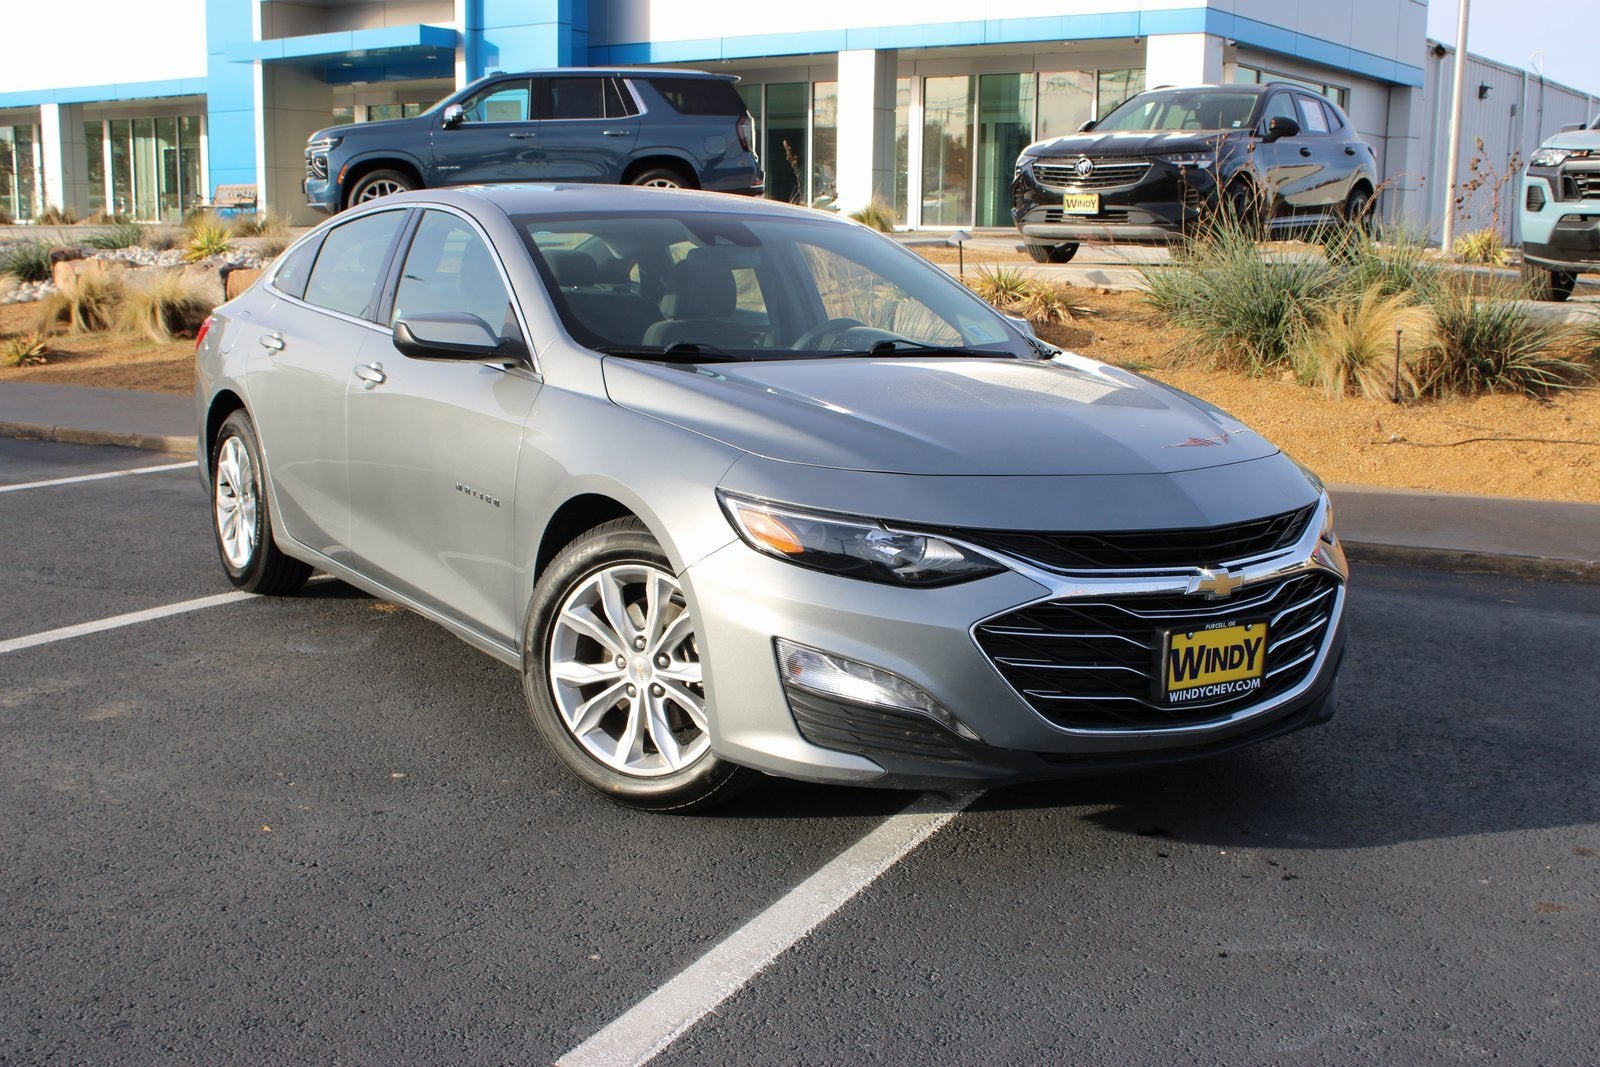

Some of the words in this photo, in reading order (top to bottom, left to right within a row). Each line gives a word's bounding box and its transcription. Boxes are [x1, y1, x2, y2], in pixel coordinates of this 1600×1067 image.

[1066, 199, 1097, 209] WINDY
[1171, 637, 1263, 682] WINDY
[1169, 678, 1261, 702] WINDYCHEV.COM
